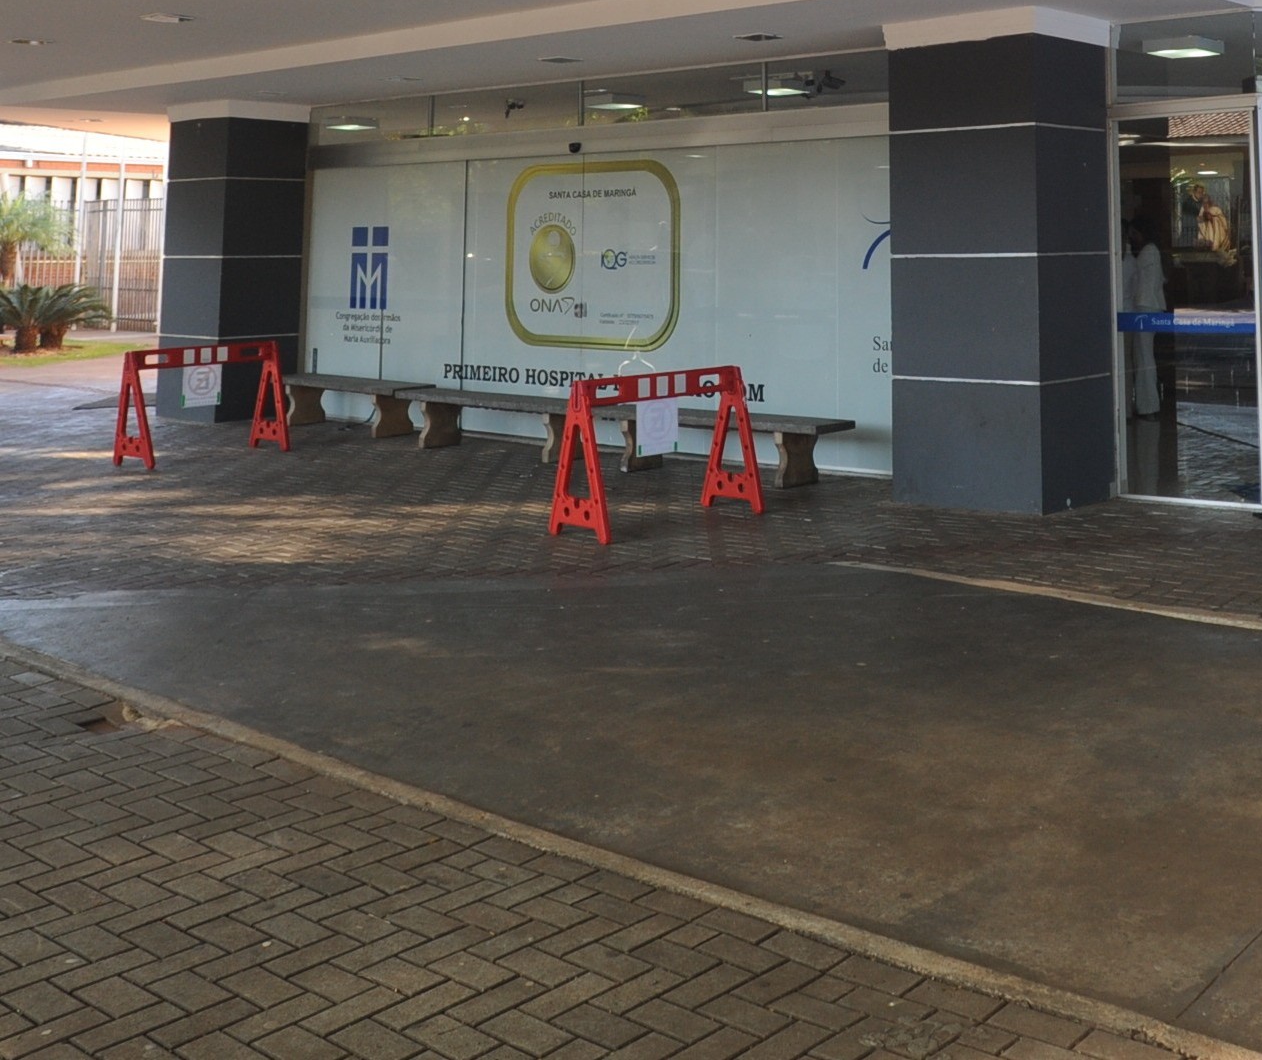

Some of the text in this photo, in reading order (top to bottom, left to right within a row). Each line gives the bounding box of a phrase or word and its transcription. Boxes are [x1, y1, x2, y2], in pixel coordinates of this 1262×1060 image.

[548, 186, 637, 200] SANTA CASA DE MARINGÁ
[530, 212, 577, 236] ACREDITADO
[1151, 317, 1171, 326] Santa
[1172, 318, 1191, 326] Casa
[1192, 317, 1202, 326] de
[872, 358, 889, 373] de
[443, 363, 520, 384] PRIMEIRO
